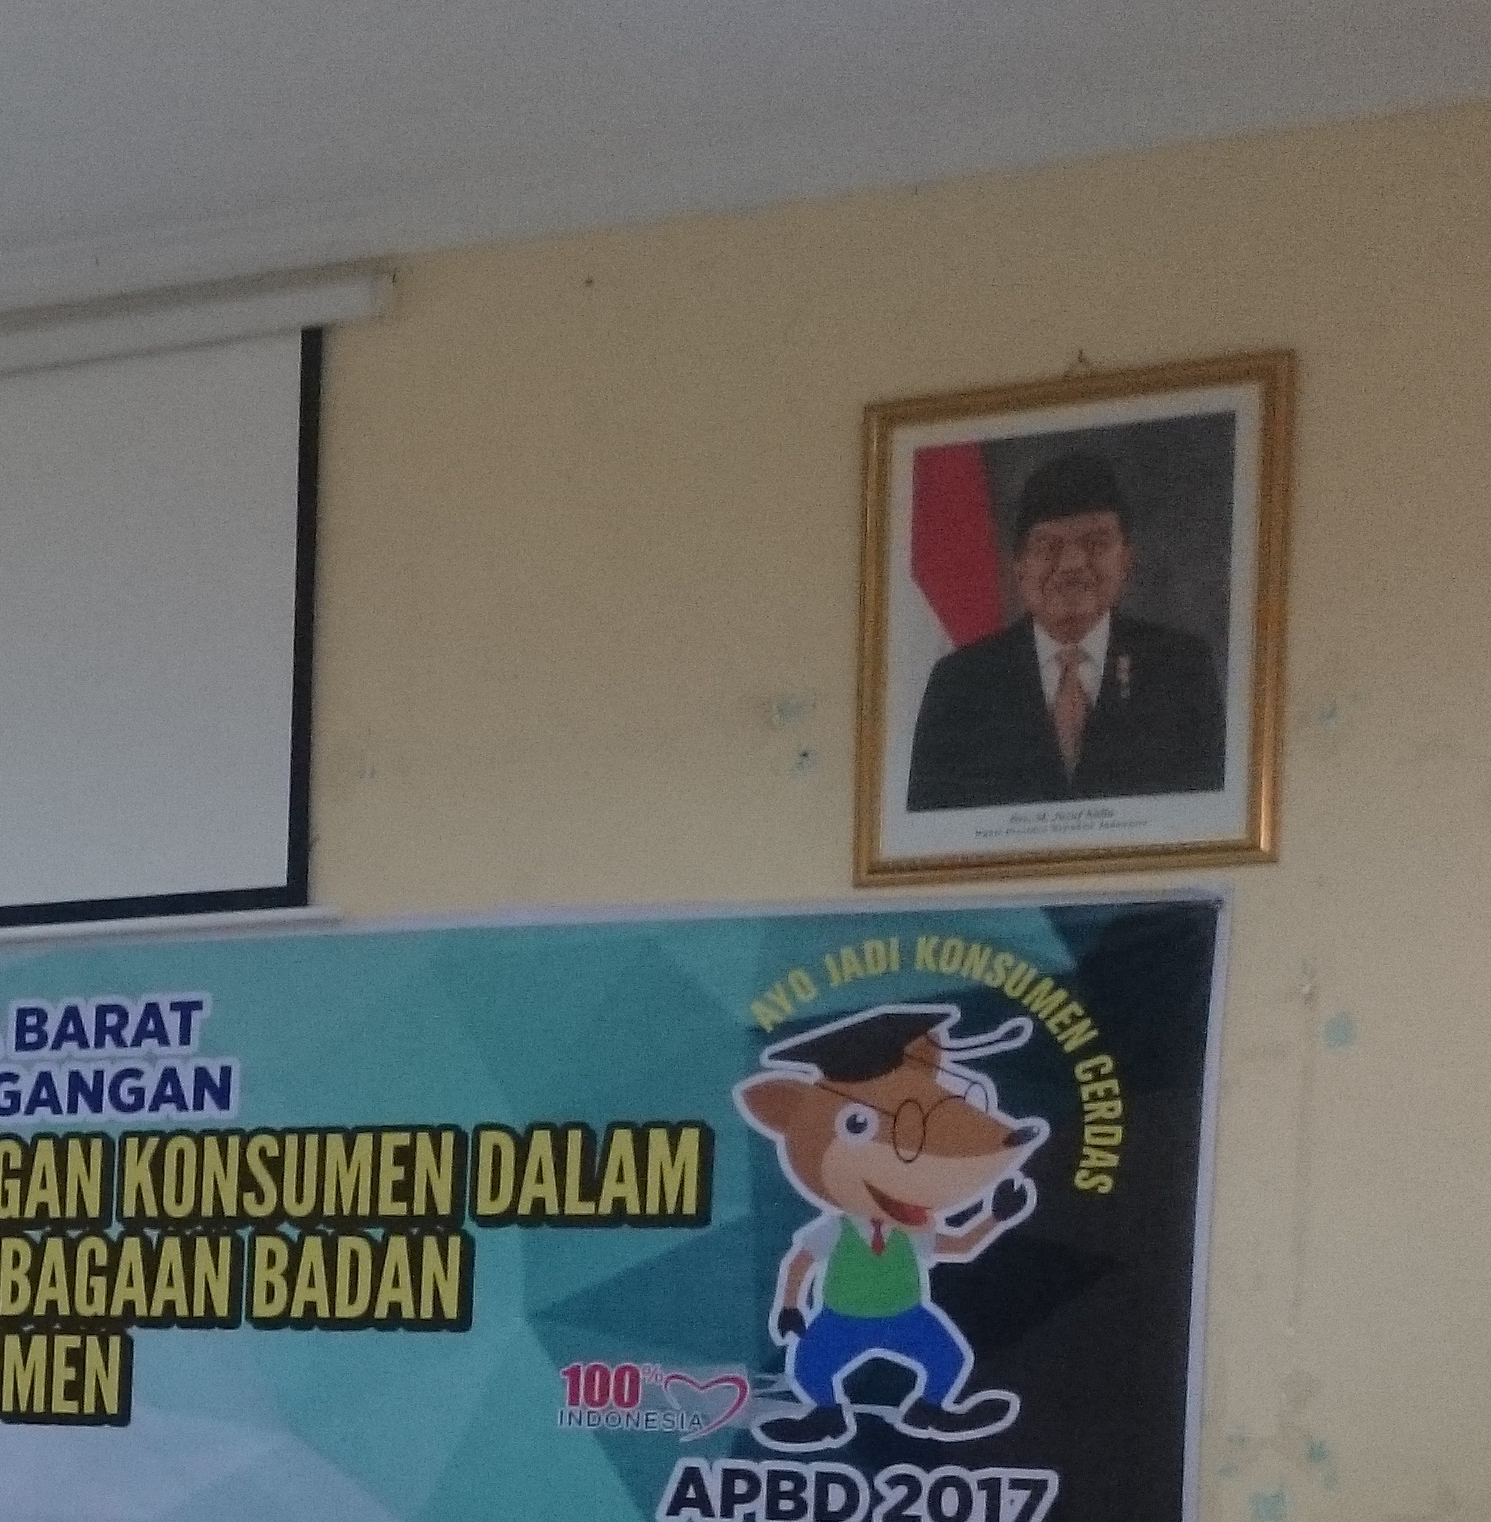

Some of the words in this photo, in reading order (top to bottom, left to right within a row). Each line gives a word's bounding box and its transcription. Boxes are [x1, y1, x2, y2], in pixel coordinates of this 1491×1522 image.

[15, 1000, 204, 1052] BARAT
[750, 968, 817, 1033] AYO
[824, 937, 901, 988] JADI
[914, 935, 1100, 1054] KONSUMEN
[1073, 1053, 1124, 1195] CERDAS
[122, 1131, 454, 1219] KONSUMEN
[476, 1127, 701, 1216] DALAM
[253, 1236, 461, 1319] BADAN
[559, 1361, 664, 1409] 100%
[558, 1409, 703, 1430] INDONESIA
